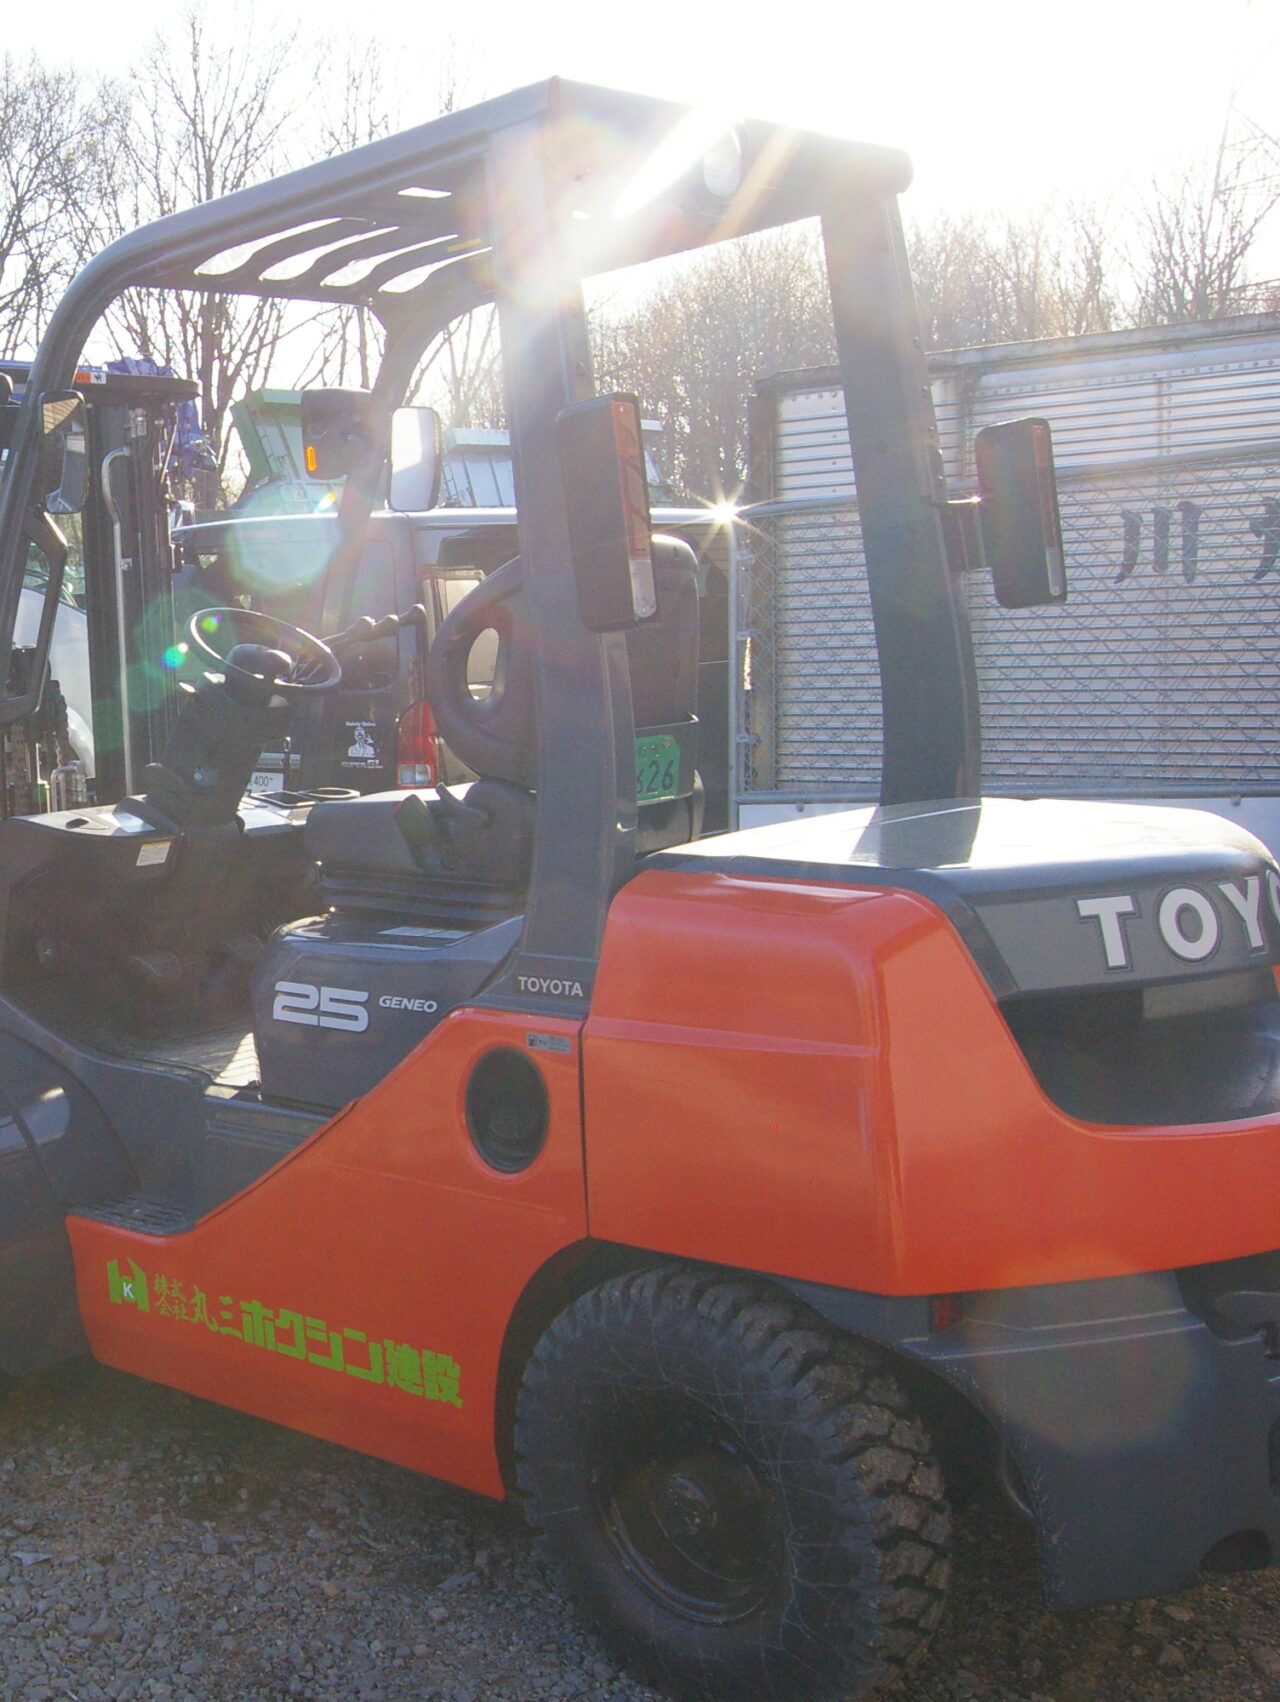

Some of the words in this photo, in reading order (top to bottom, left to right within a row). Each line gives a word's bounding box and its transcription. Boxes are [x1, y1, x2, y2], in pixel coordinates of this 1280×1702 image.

[517, 976, 584, 998] TOYOTA
[273, 981, 369, 1033] 25
[378, 995, 438, 1014] GENEO
